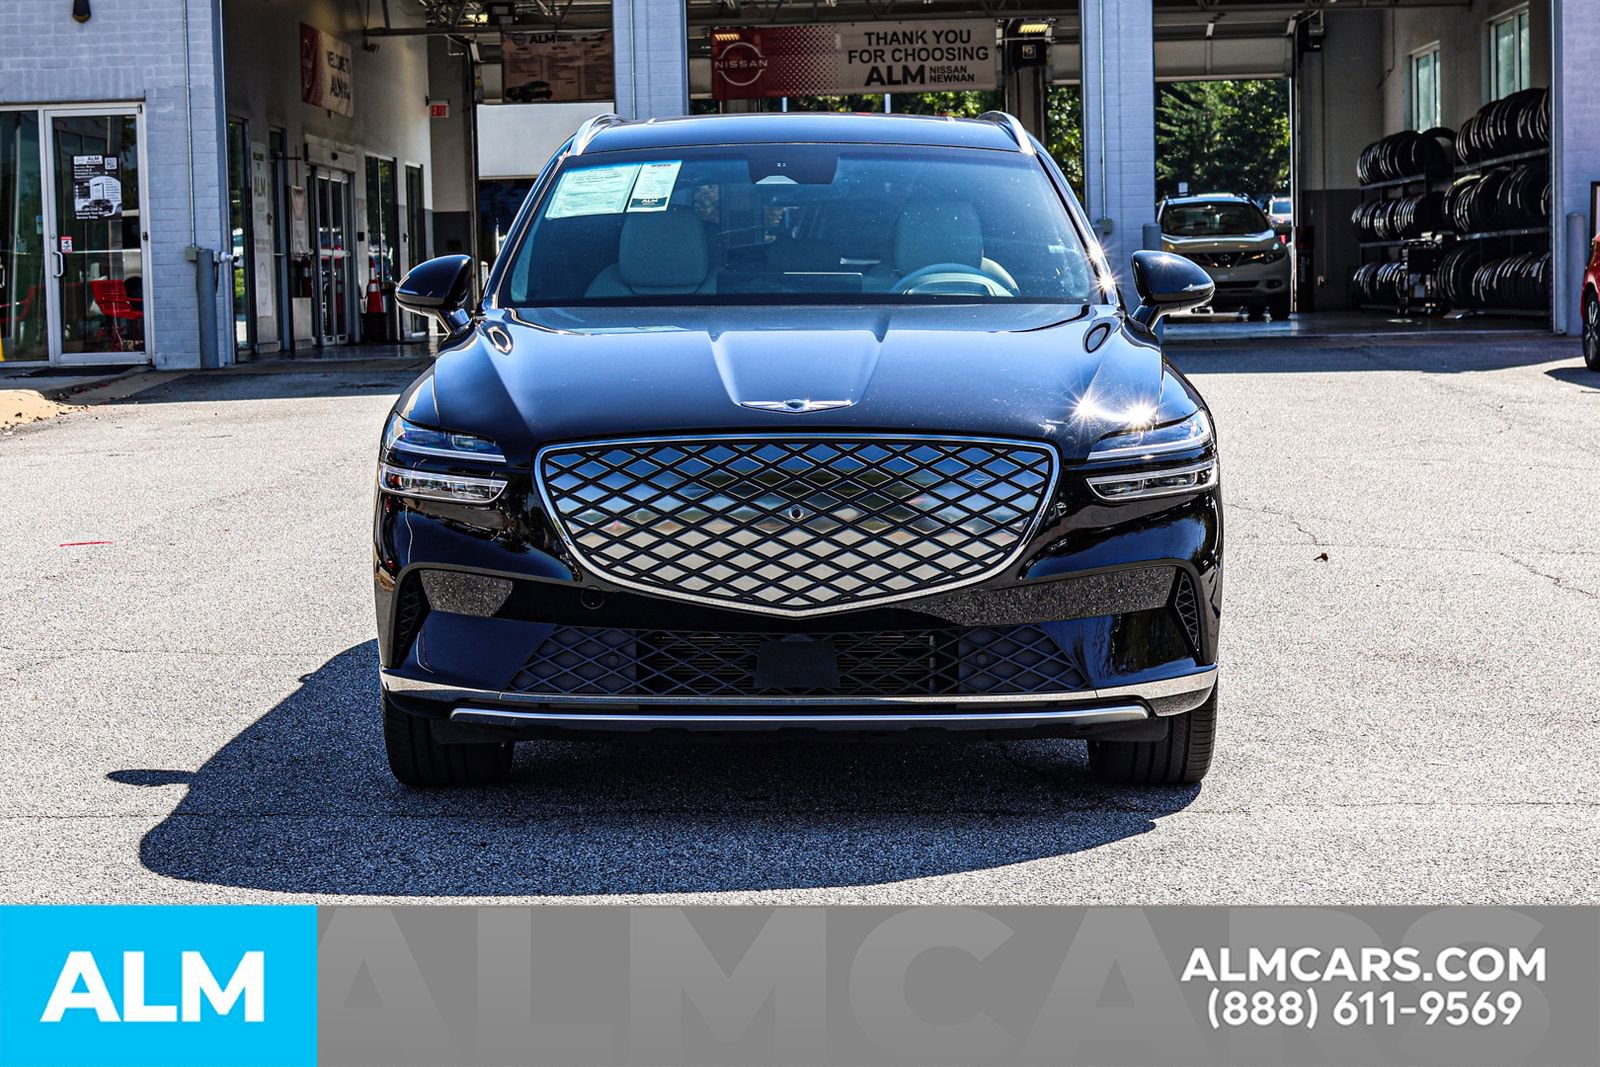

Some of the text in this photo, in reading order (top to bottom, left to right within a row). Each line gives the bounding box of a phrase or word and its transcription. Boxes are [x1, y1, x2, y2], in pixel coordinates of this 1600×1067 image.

[529, 35, 556, 44] ALM
[864, 29, 971, 46] THANK YOU
[848, 46, 989, 64] FOR CHOOSING
[714, 59, 768, 69] NISSAN
[929, 65, 967, 74] NISSAN
[864, 65, 925, 86] ALM
[929, 74, 975, 83] NEWNAN
